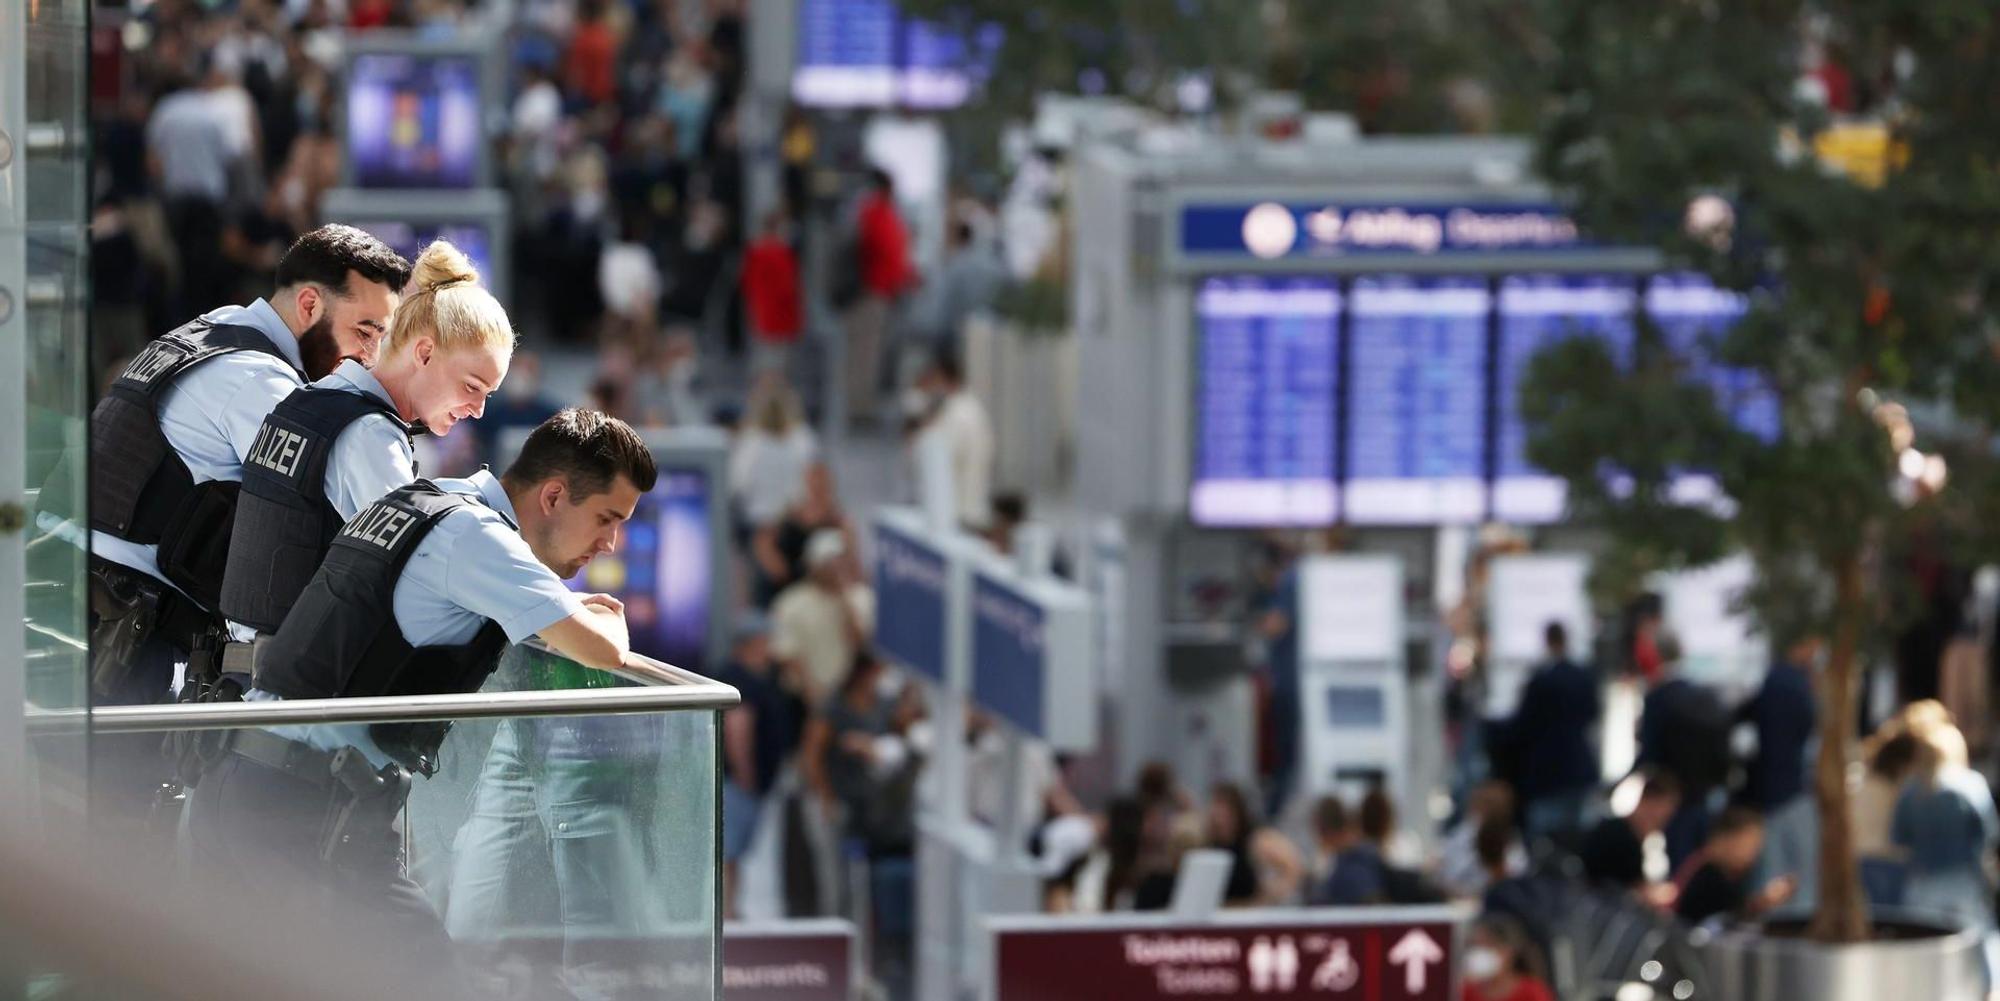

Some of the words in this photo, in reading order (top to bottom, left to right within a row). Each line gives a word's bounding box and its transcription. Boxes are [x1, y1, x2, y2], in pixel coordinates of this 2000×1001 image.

[122, 347, 180, 383] OLIZEI
[249, 422, 308, 478] OLIZEI
[343, 503, 417, 551] OLIZEI
